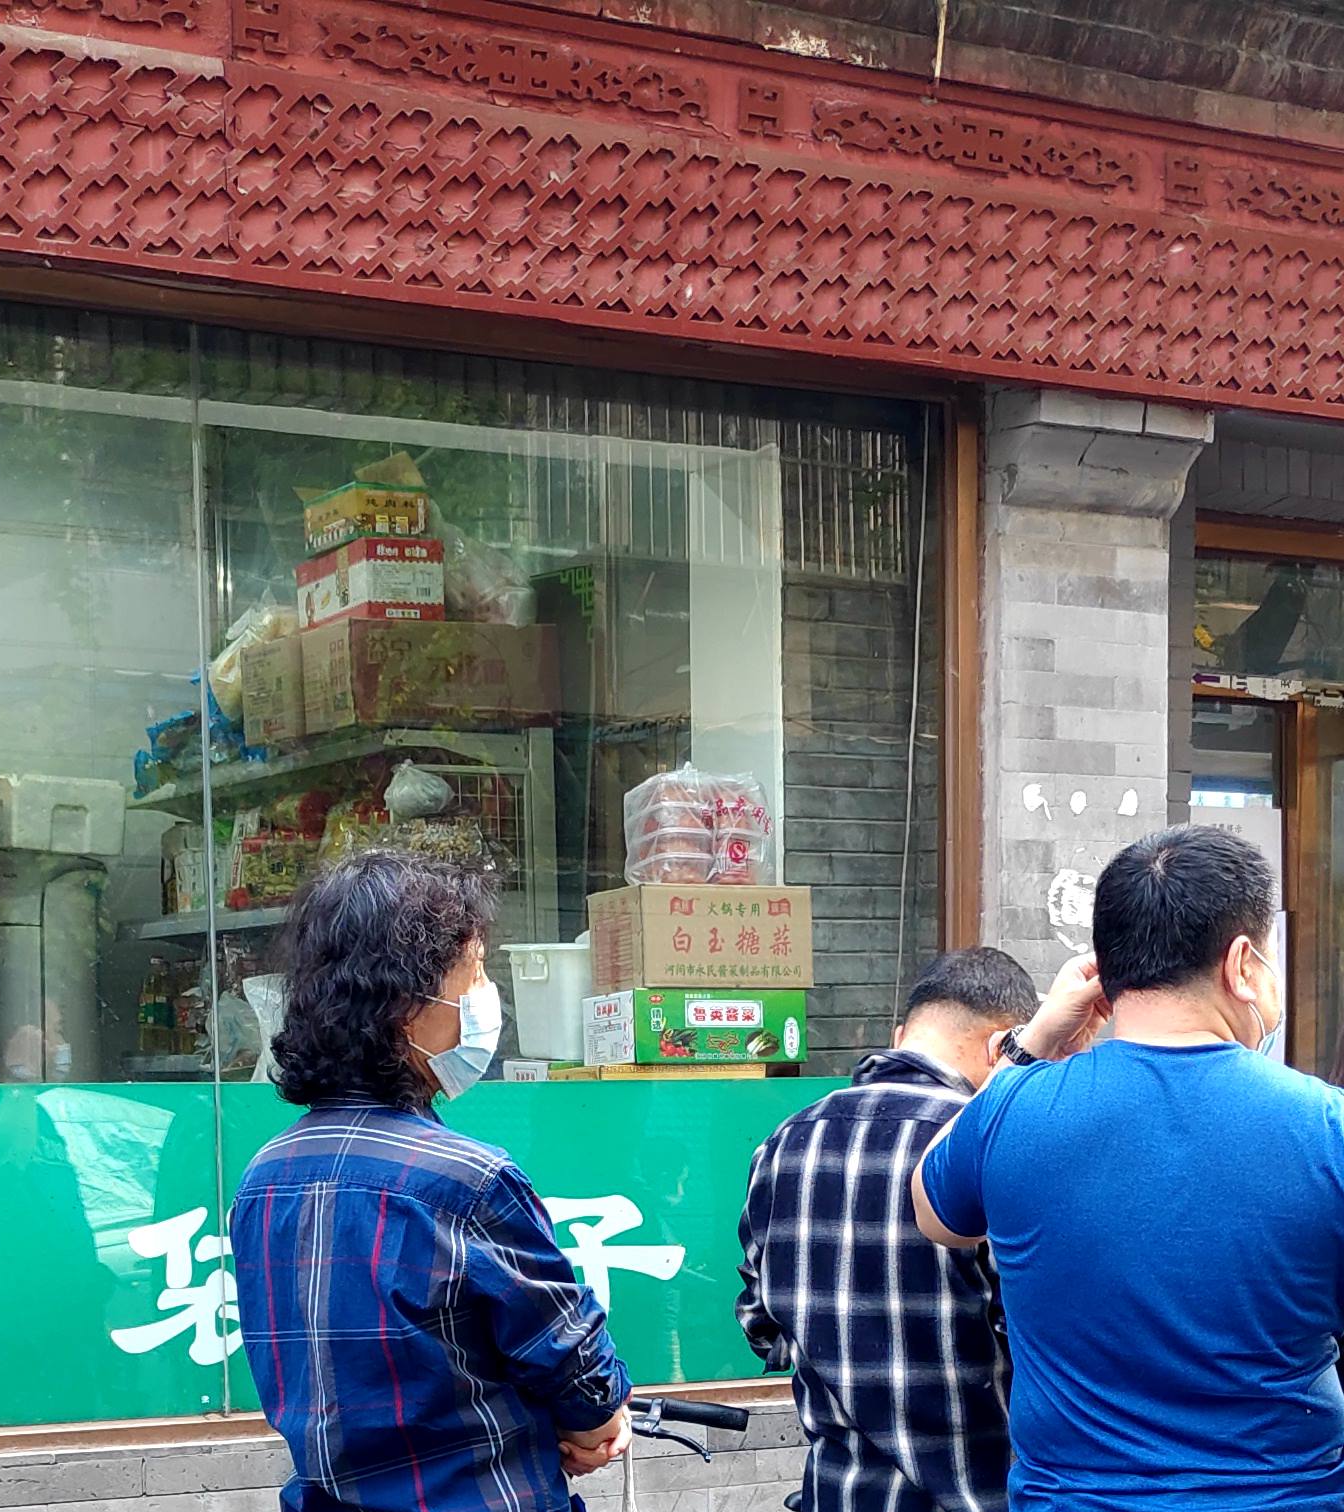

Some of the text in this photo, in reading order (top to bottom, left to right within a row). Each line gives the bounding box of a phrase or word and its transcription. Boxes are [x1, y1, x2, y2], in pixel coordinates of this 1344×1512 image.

[707, 902, 761, 917] 火锅专用
[672, 924, 793, 957] 白玉糖蒜
